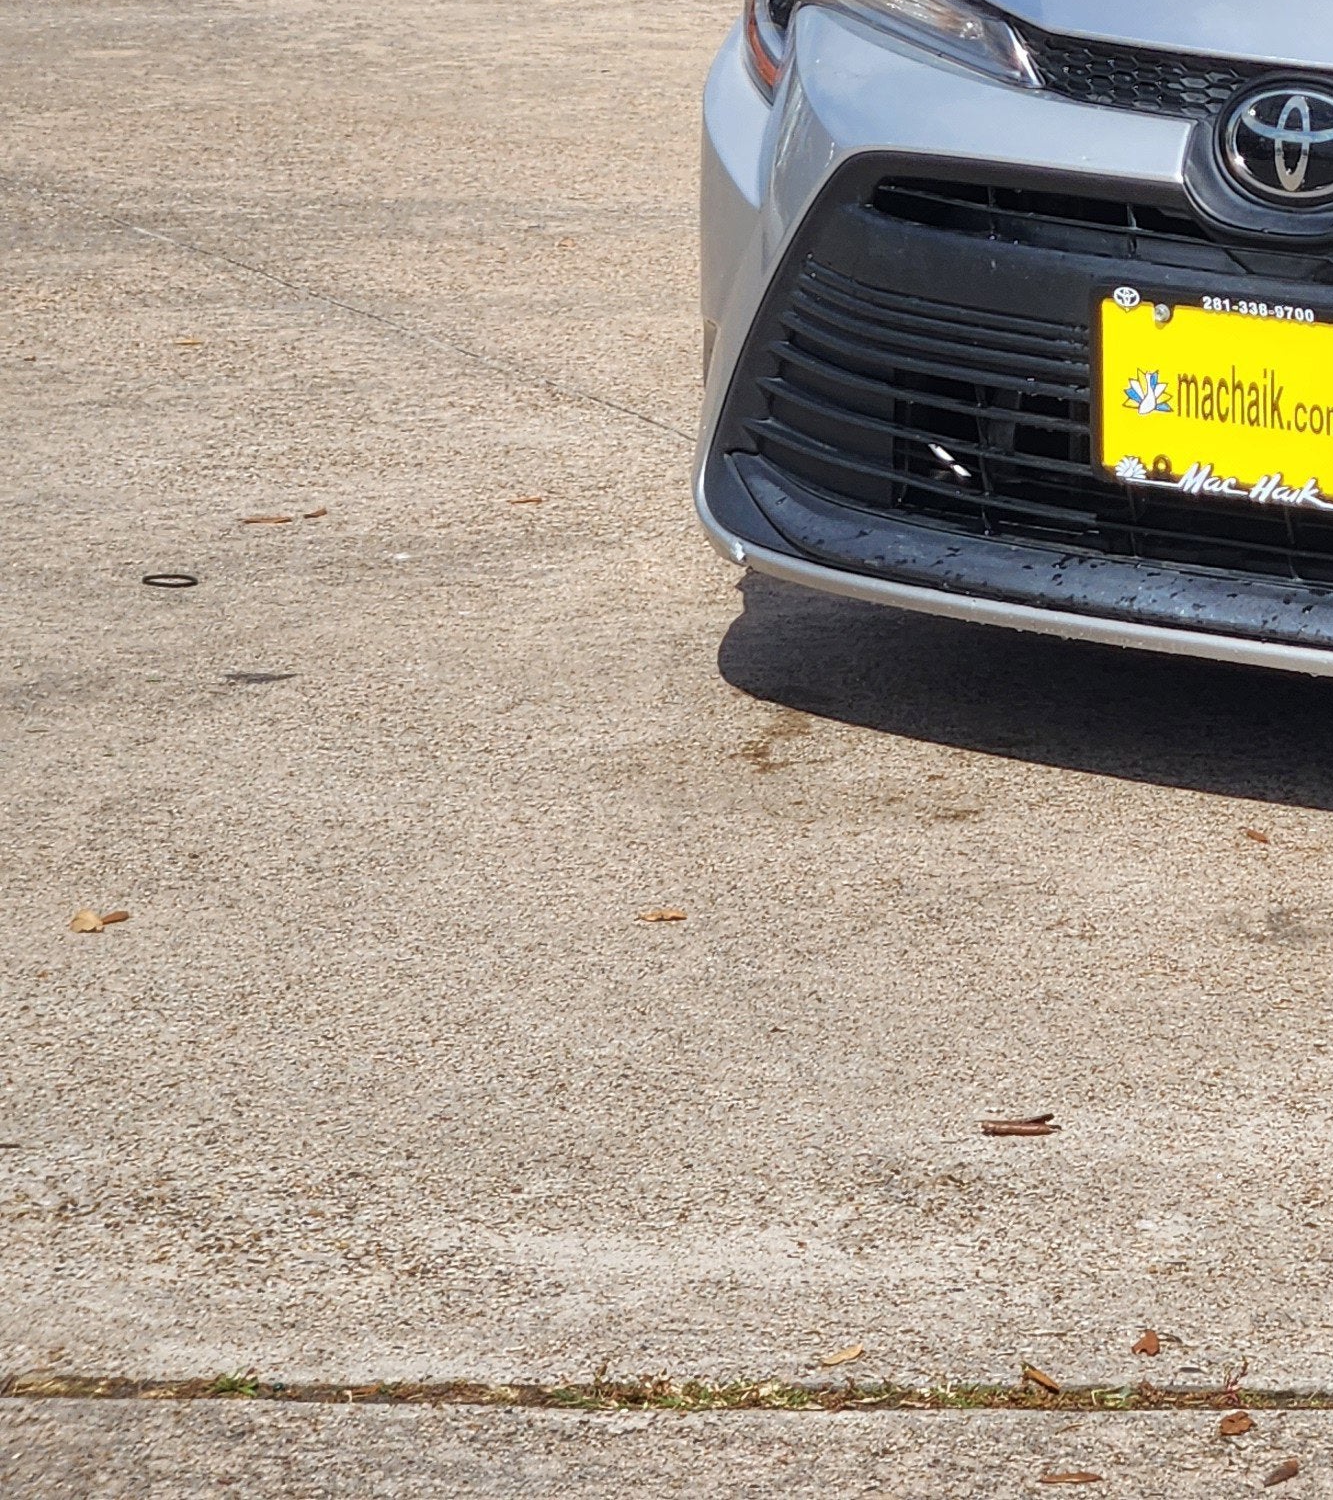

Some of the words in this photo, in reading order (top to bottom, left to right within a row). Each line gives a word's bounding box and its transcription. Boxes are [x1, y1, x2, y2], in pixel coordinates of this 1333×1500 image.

[1202, 295, 1315, 323] 281-338-9700
[1175, 461, 1246, 497] Mac
[1247, 470, 1332, 508] Haik
